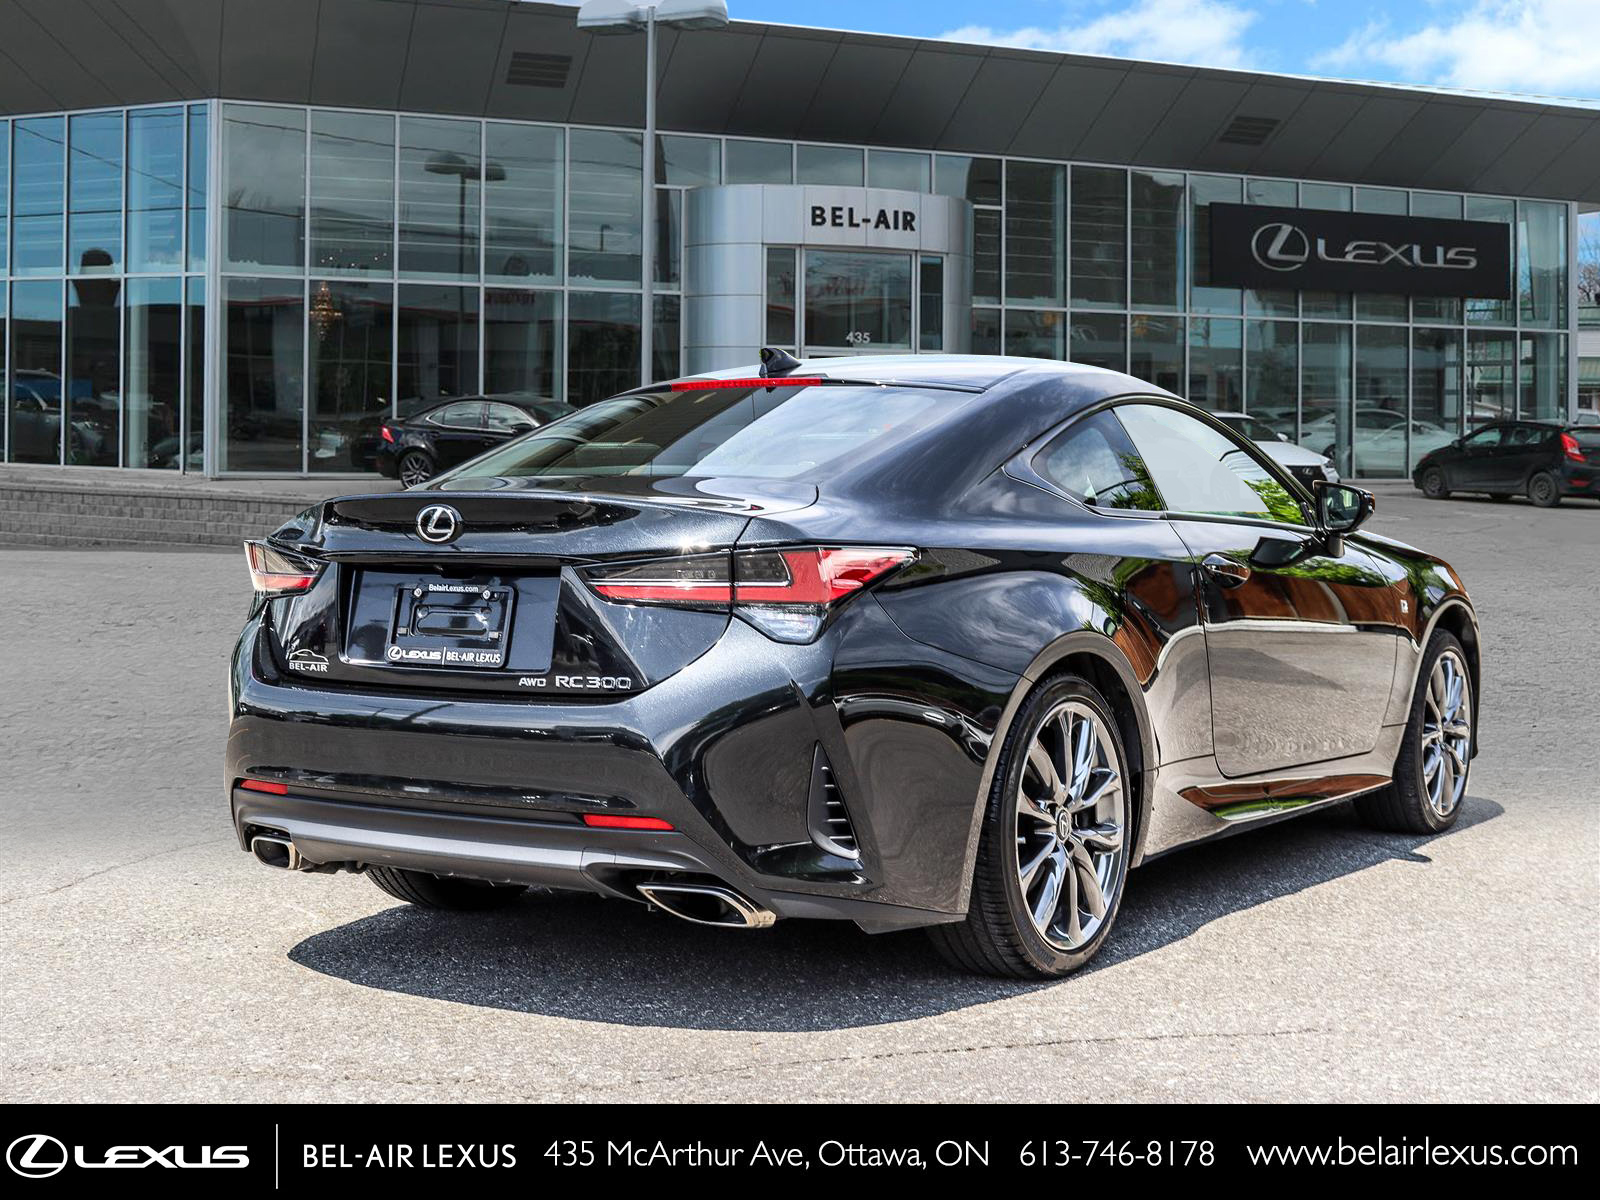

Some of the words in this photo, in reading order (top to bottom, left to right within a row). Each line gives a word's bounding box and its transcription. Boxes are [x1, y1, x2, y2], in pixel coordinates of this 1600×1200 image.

[811, 206, 916, 231] BEL-AIR
[1317, 238, 1477, 269] LEXUS
[846, 331, 871, 344] 435
[428, 583, 479, 593] BelairLexus.com
[402, 649, 442, 660] LEXUS
[446, 651, 475, 662] BEL-AIR
[476, 653, 501, 664] LEXUS
[289, 662, 328, 673] BEL-AIR
[518, 677, 547, 687] AWD
[555, 675, 584, 689] RC
[586, 676, 632, 690] 300
